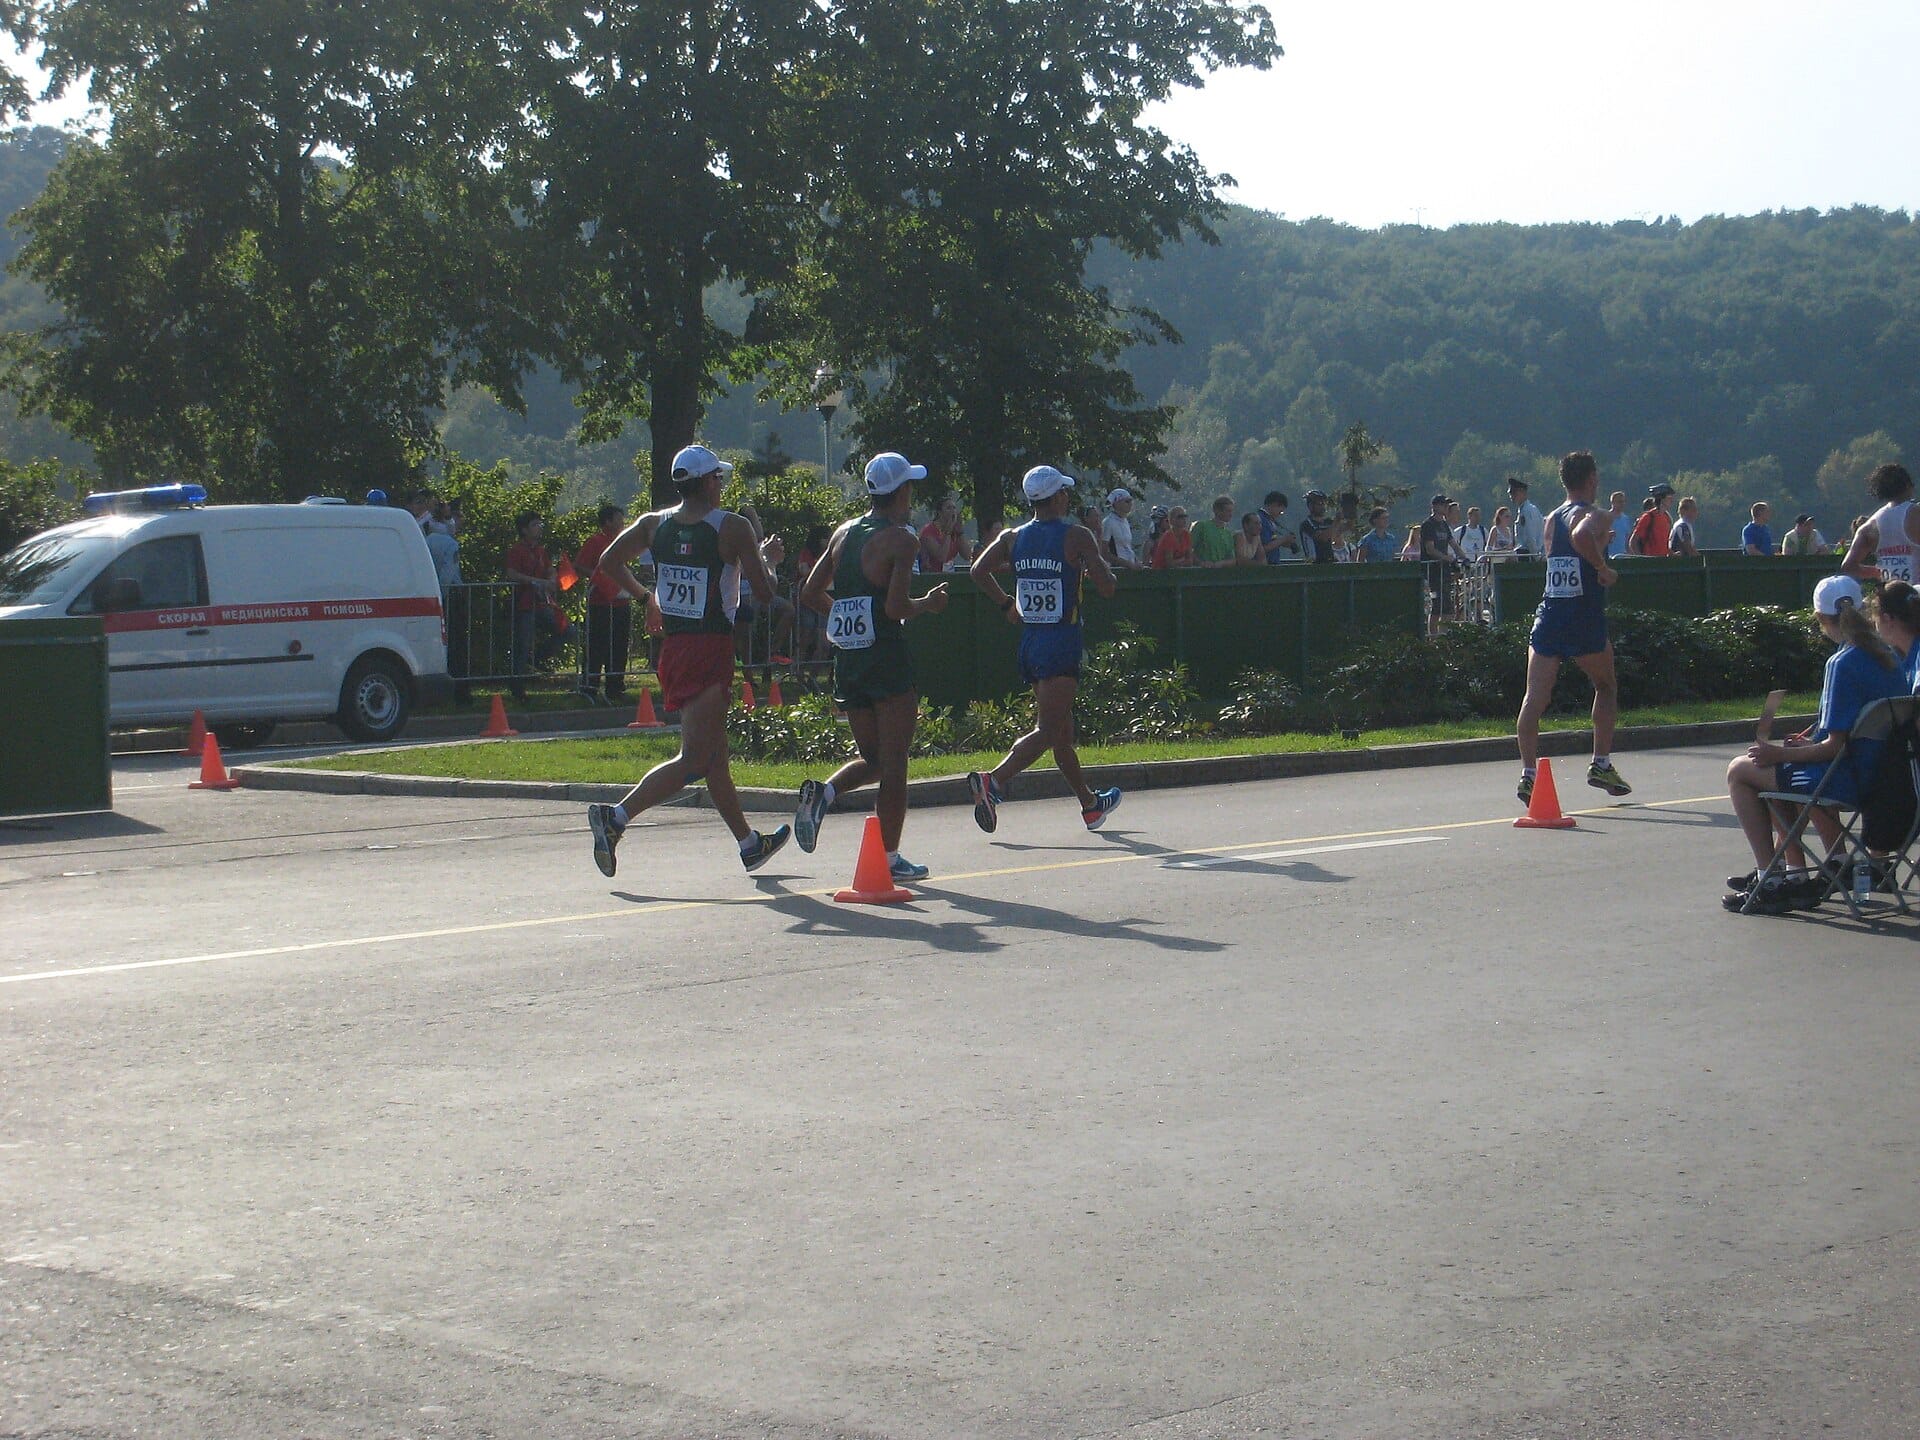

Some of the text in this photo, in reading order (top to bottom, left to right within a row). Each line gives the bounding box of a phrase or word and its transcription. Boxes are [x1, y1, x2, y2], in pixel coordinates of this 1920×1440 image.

[1015, 558, 1063, 573] COLOMBIA
[1554, 558, 1576, 568] TDK
[1882, 557, 1908, 566] TDK
[669, 567, 702, 582] TDK
[1548, 571, 1580, 588] 1096
[1880, 568, 1911, 582] 066
[1028, 580, 1057, 591] TDK
[666, 582, 696, 606] 791
[841, 598, 867, 613] TDK
[1023, 594, 1057, 612] 298
[158, 604, 374, 624] СКОРАЯ МЕДИЦИНСКАЯ ПОМОЩЬ
[832, 614, 868, 638] 206
